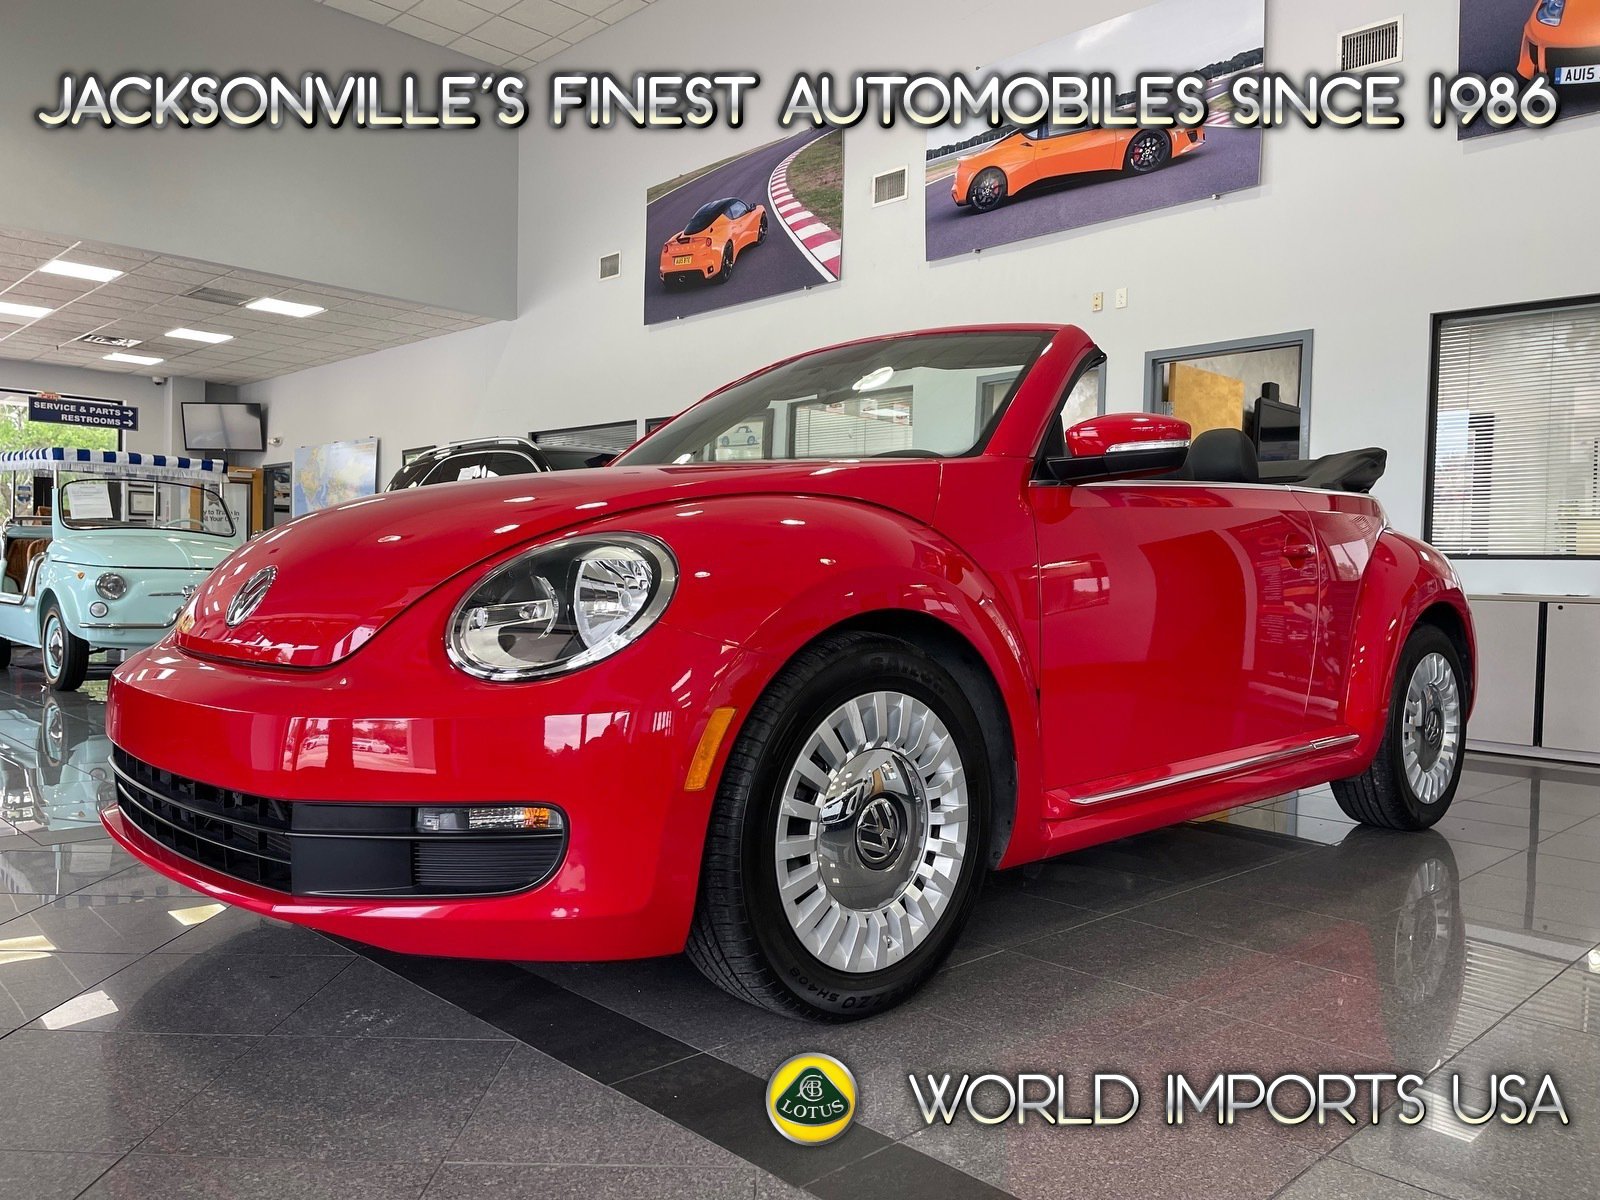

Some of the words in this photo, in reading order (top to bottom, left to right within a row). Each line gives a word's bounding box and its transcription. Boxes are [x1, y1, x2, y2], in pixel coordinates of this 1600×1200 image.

[1564, 67, 1595, 82] AU15
[33, 401, 77, 412] SERVICE
[79, 406, 87, 414] &
[89, 407, 121, 417] PARTS
[61, 413, 121, 426] RESTROOMS
